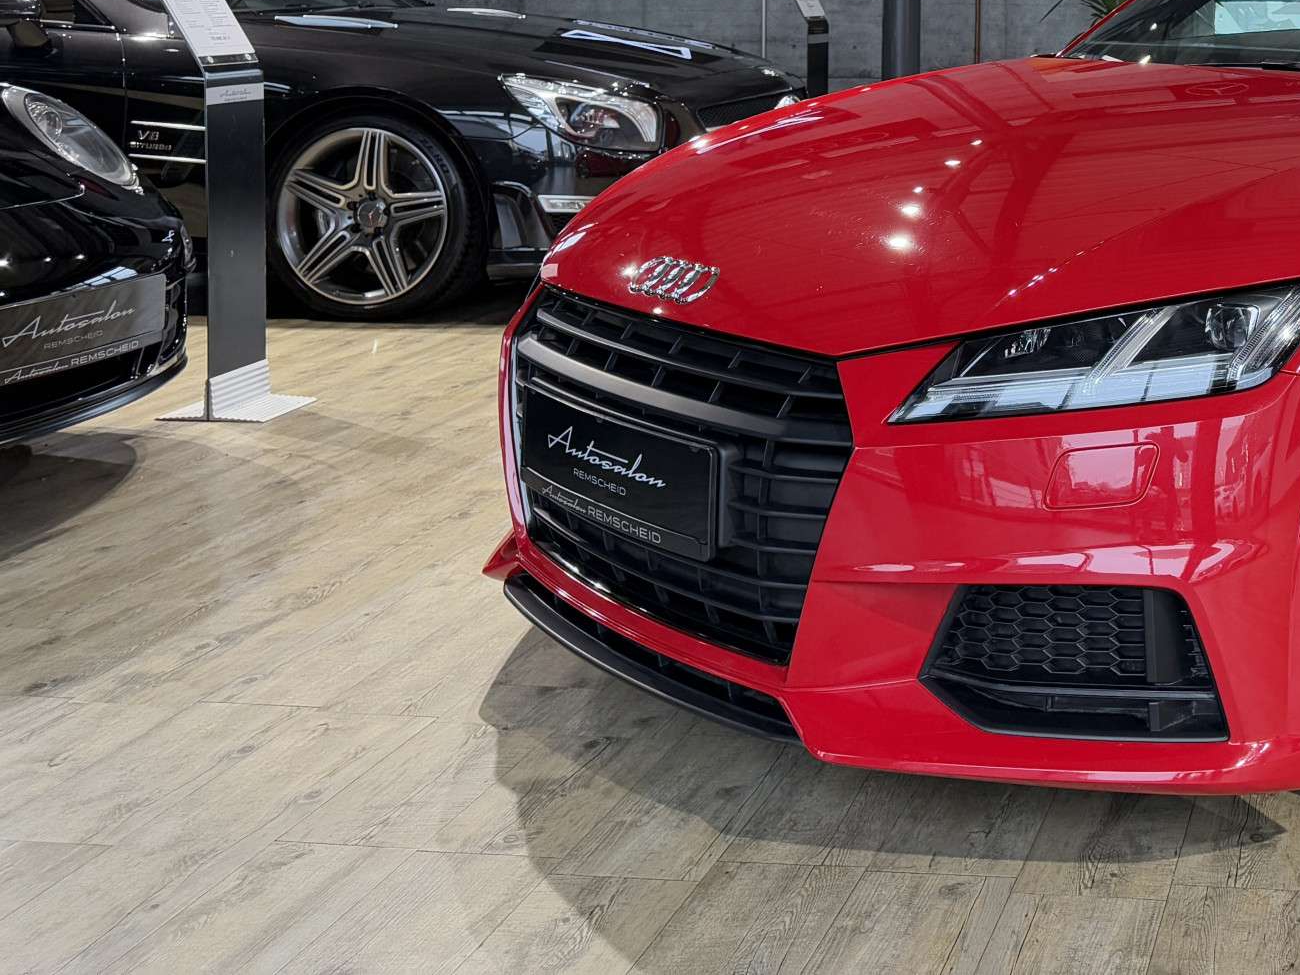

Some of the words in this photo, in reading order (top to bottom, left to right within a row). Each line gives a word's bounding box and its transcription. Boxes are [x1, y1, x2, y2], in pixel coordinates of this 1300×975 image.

[138, 130, 160, 141] V8
[2, 299, 137, 348] Autosalon
[43, 330, 104, 350] REMSCHEID
[70, 340, 139, 366] REMSCHEID
[547, 426, 667, 488] Autosalon
[573, 468, 627, 496] REMSCHEID
[587, 505, 663, 544] REMSCHEID
